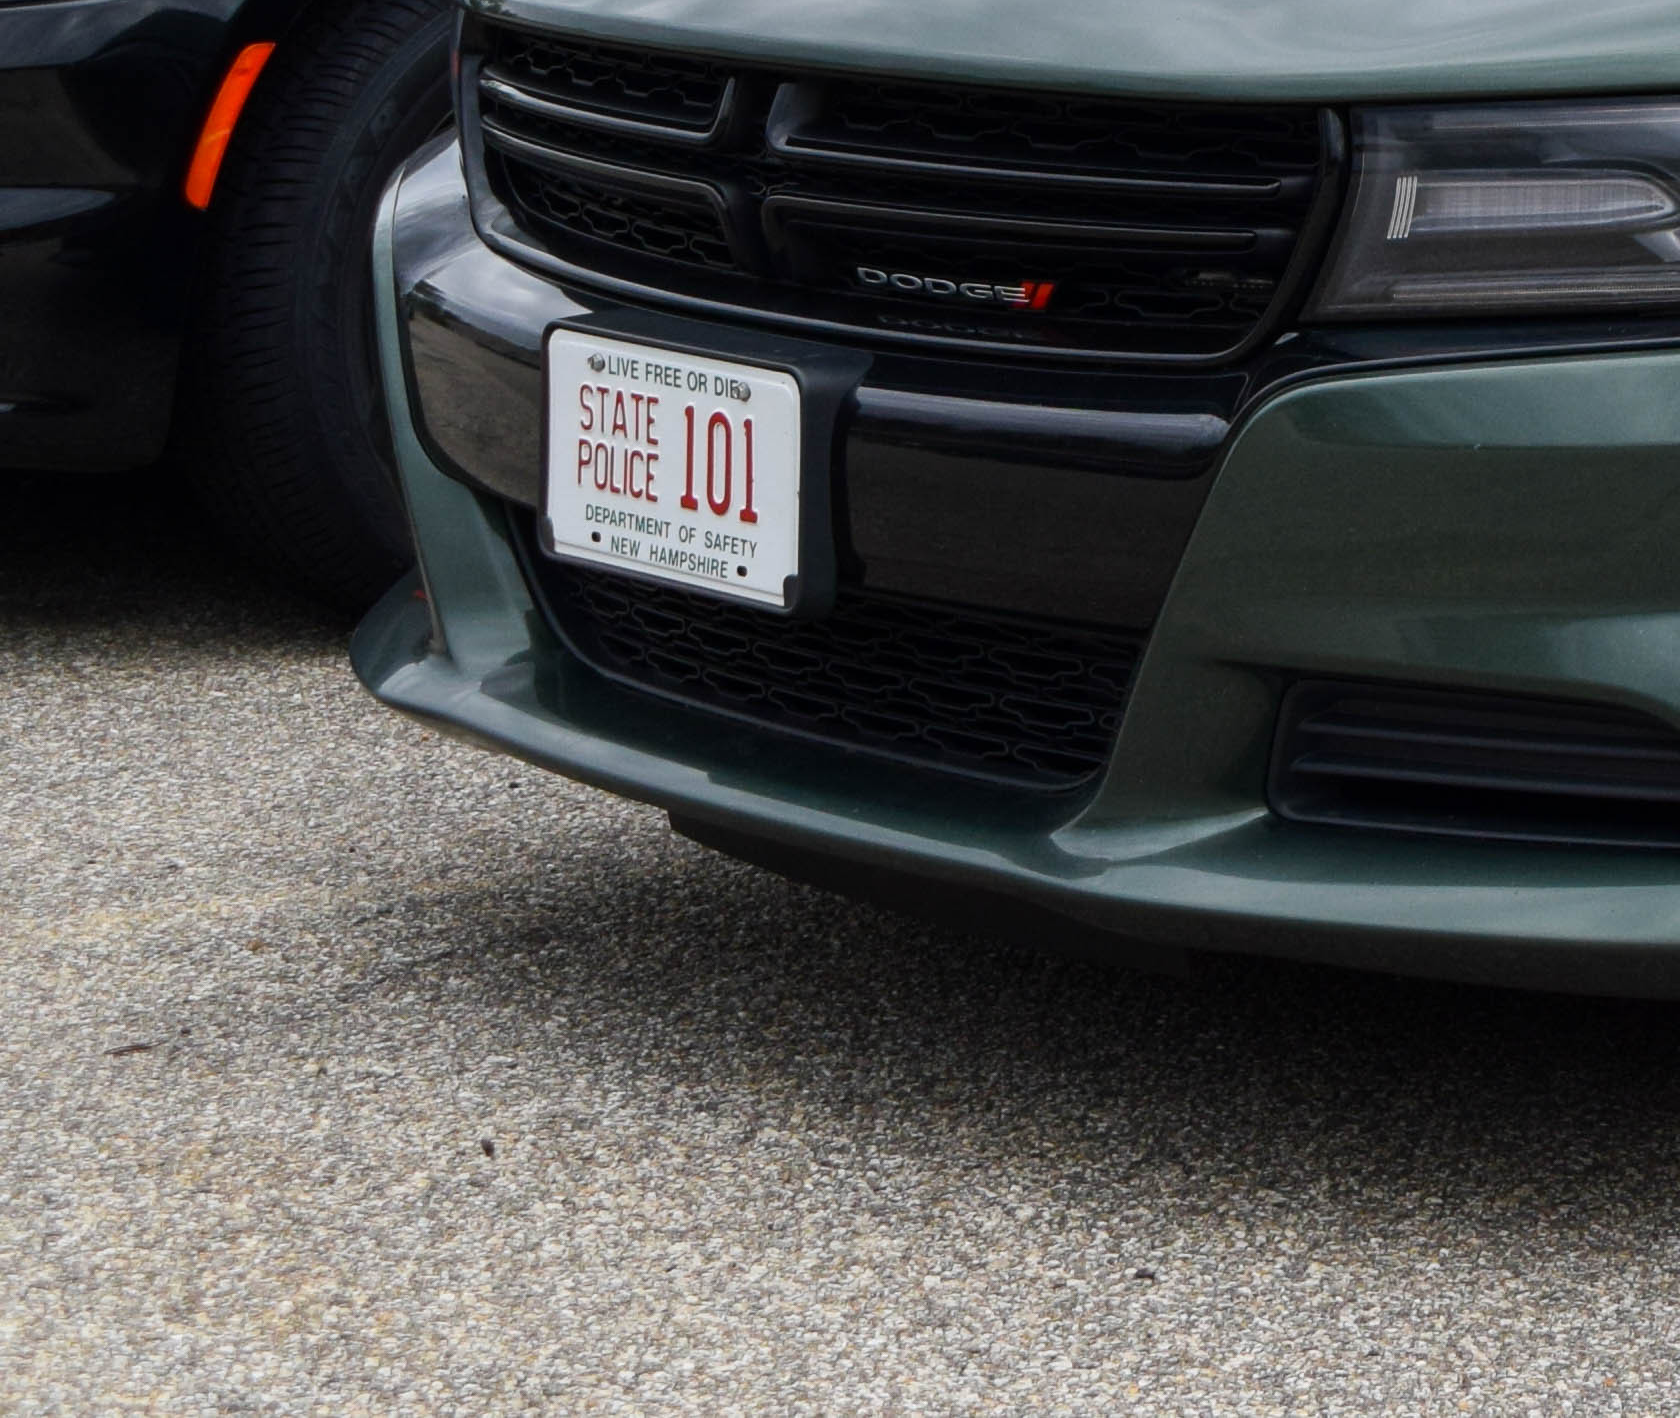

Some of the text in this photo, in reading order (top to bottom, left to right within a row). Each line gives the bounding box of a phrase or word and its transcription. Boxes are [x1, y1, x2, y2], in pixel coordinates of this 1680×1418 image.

[857, 267, 1030, 303] DODGE
[608, 355, 639, 379] LIVE
[645, 363, 683, 388] FREE
[687, 370, 708, 393] OR
[580, 384, 659, 445] STATE
[577, 439, 659, 502] POLICE
[680, 405, 758, 524] 101
[585, 504, 757, 558] DEPARTMENT OF SAFETY
[610, 535, 728, 578] NEW HAMPSHIRE
